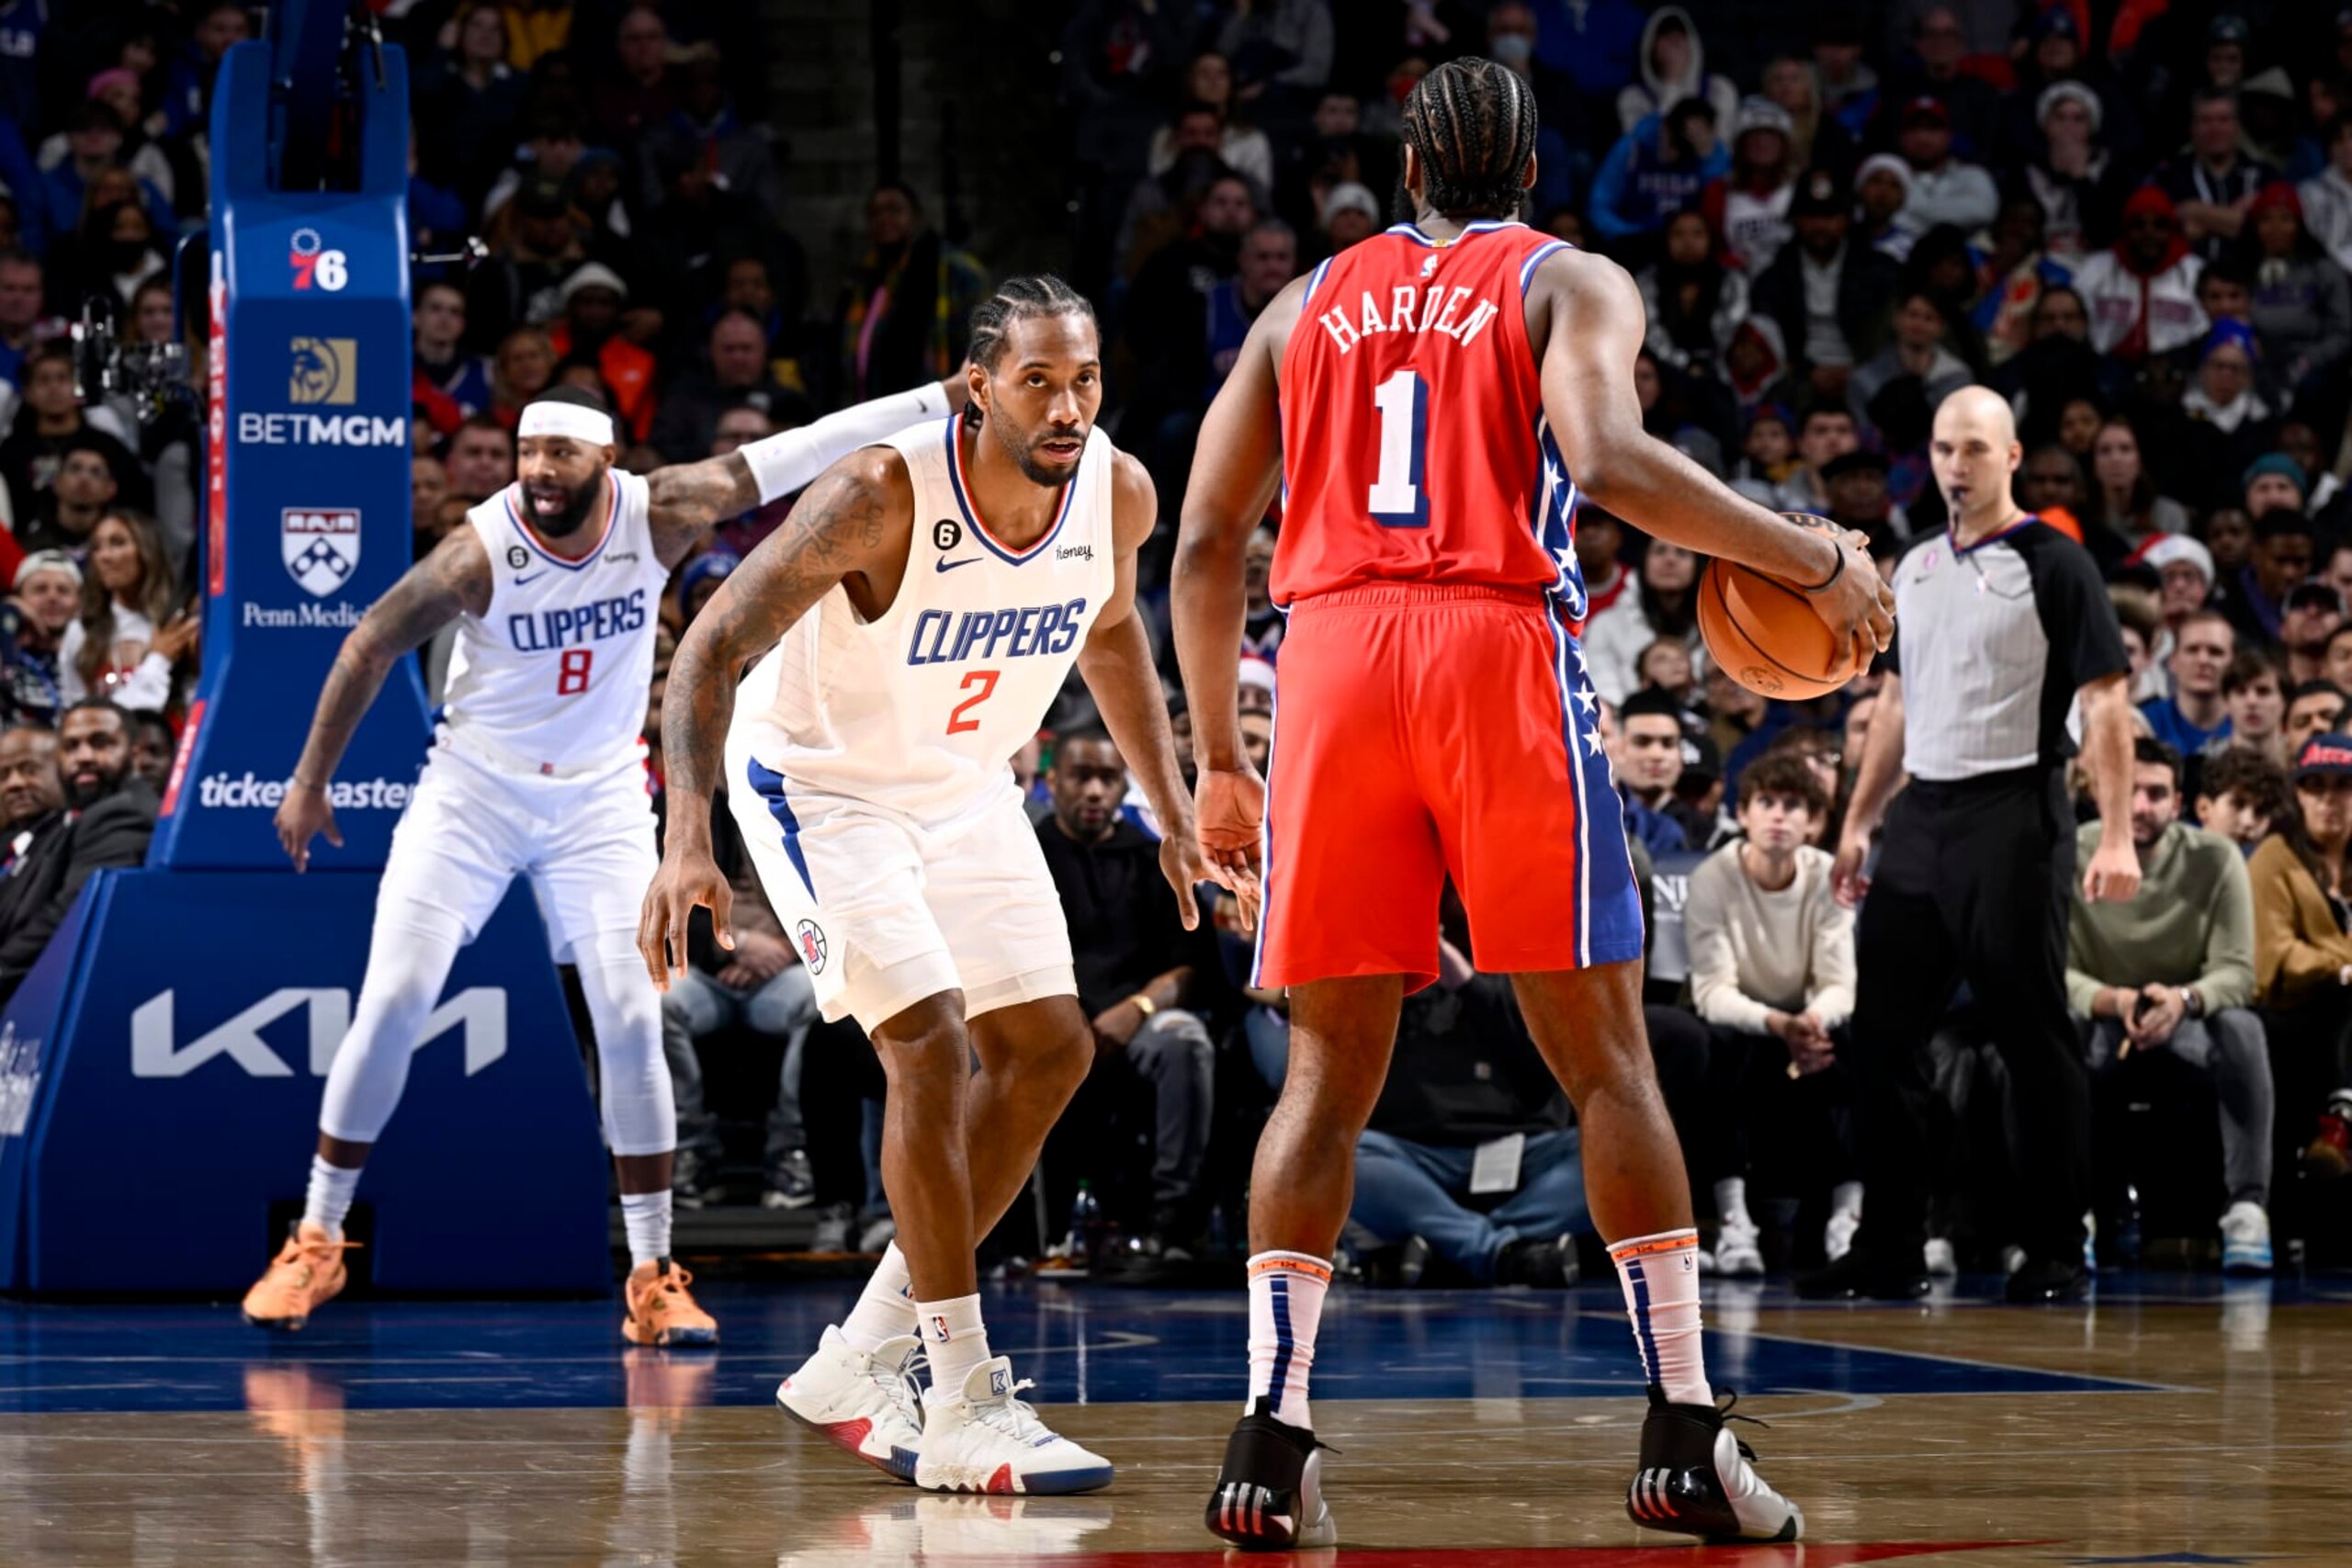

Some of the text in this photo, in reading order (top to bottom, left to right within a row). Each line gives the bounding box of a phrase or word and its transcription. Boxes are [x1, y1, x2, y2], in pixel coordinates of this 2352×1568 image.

[288, 249, 348, 291] 76
[1318, 284, 1498, 355] HARDEN
[239, 413, 405, 446] BETMGM
[1368, 370, 1430, 528] 1
[512, 550, 526, 566] 6
[938, 524, 956, 547] 6
[1055, 544, 1095, 561] honey
[243, 601, 371, 627] Penn Medic
[508, 589, 646, 652] CLIPPERS
[907, 597, 1087, 666] CLIPPERS
[557, 649, 594, 695] 8
[945, 670, 1001, 736] 2
[131, 987, 507, 1077] KIA
